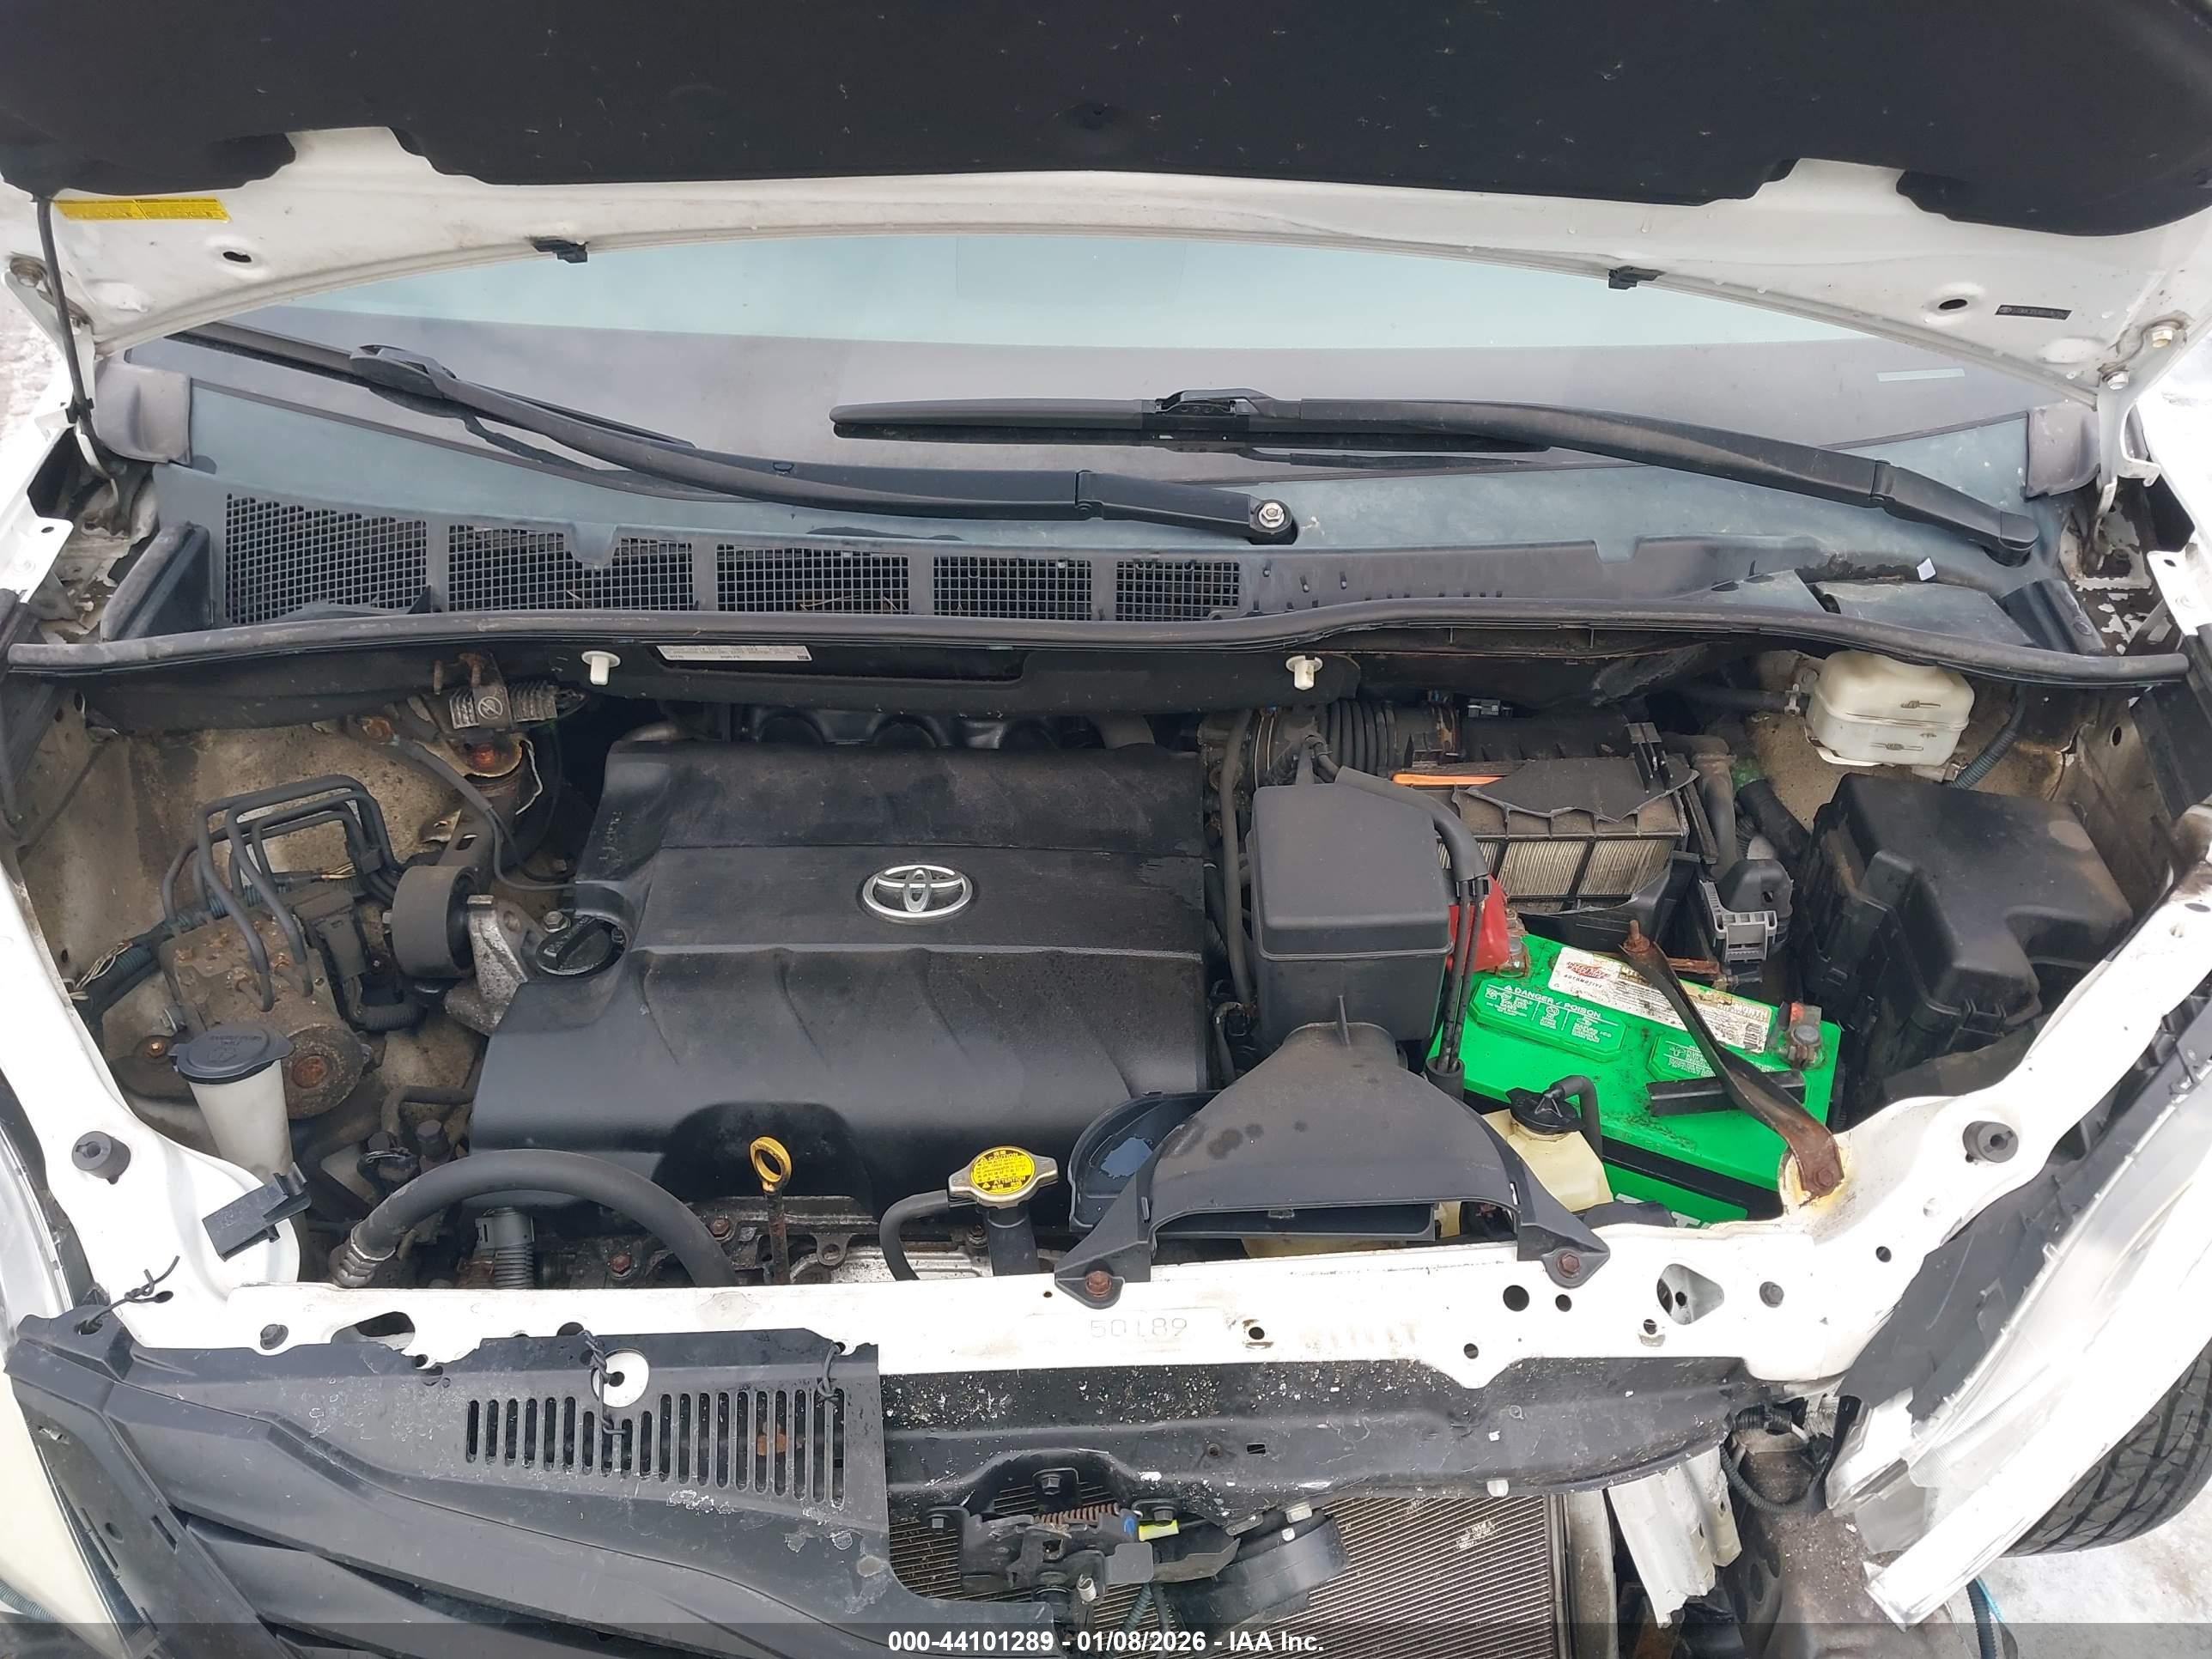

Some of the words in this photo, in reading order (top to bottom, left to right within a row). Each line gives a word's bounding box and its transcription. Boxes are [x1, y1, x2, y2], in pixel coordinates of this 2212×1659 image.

[1564, 974, 1603, 988] AUTOMOTIVE
[1514, 987, 1553, 1004] DANGER
[1564, 1002, 1601, 1018] POISON
[988, 1152, 1018, 1161] CAUTION
[994, 1176, 1026, 1185] ATTENTION
